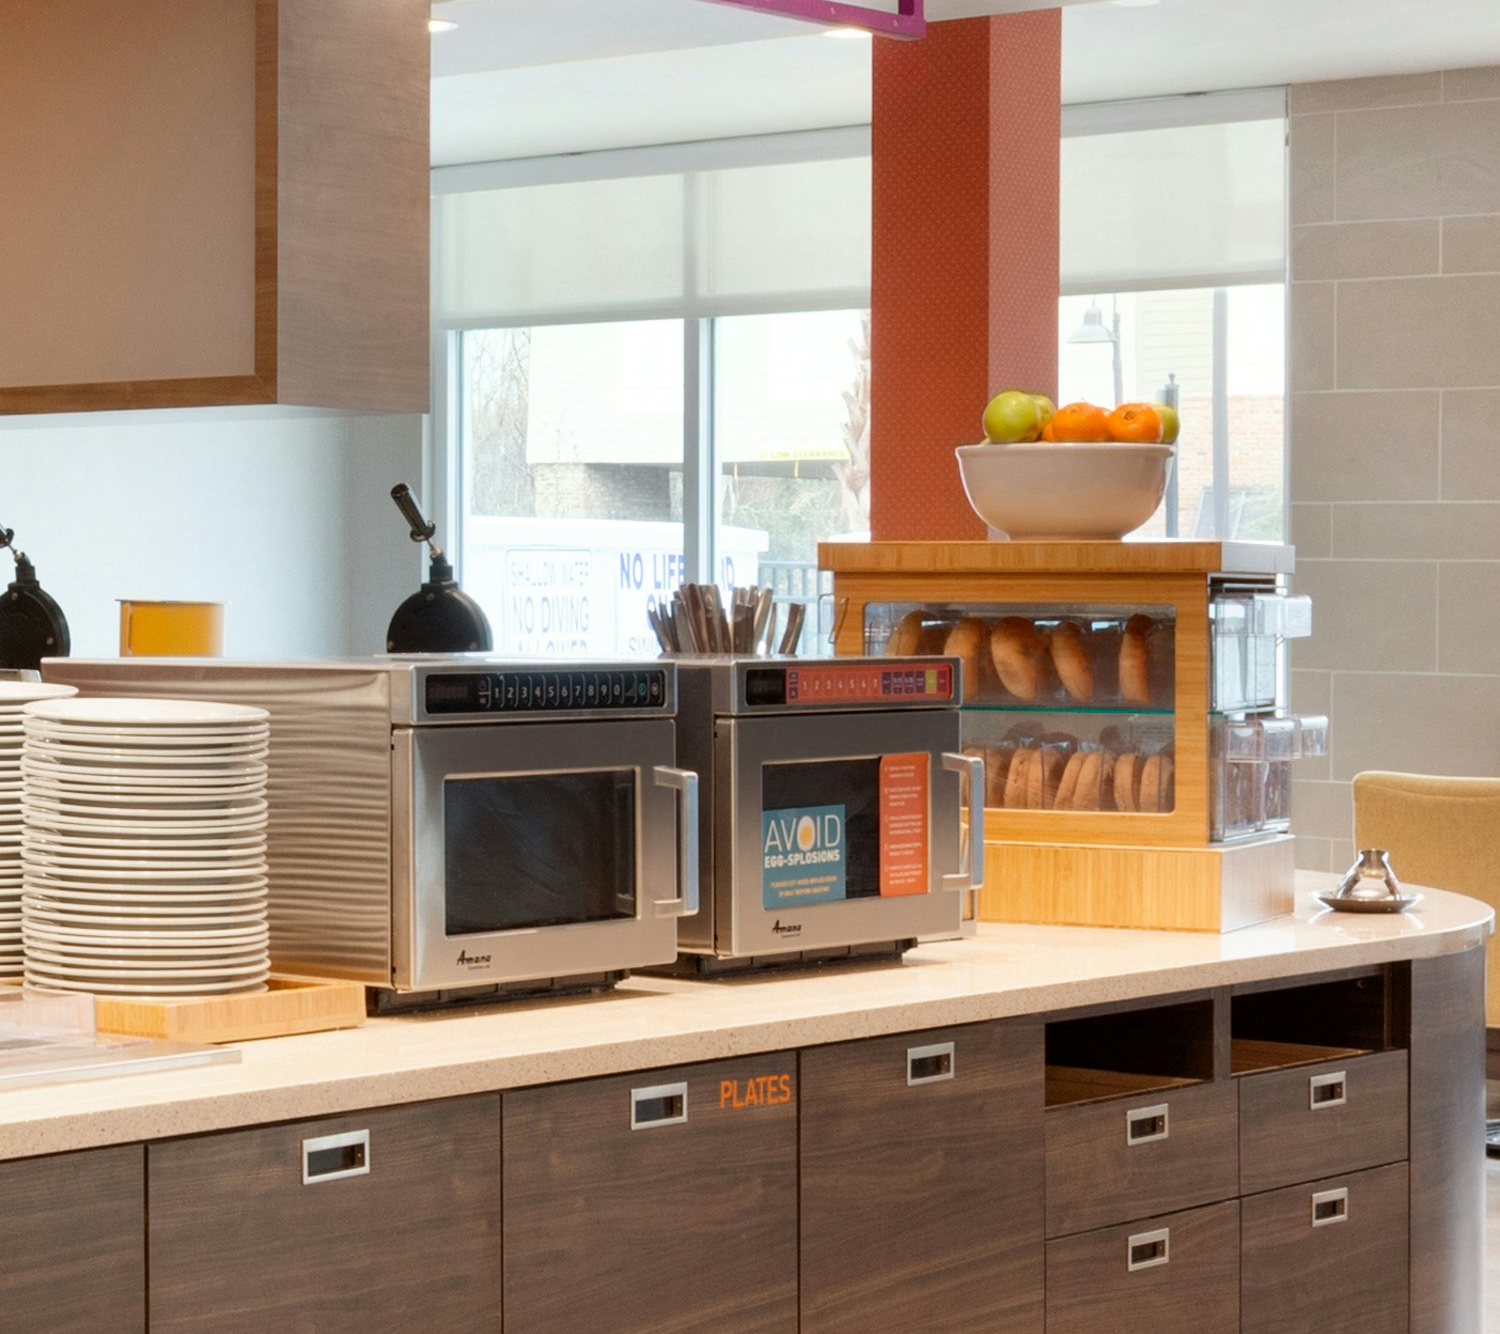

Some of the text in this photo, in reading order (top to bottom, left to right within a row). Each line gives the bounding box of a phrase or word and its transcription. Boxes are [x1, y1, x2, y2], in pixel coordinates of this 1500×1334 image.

[619, 553, 643, 590] NO
[513, 596, 589, 634] NO DIVING
[495, 684, 620, 699] 1 2 3 4 5 6 7 8 9 0
[765, 814, 841, 853] AVOID
[764, 849, 840, 868] EGG-SPLOSIONS
[719, 1074, 791, 1109] PLATES
